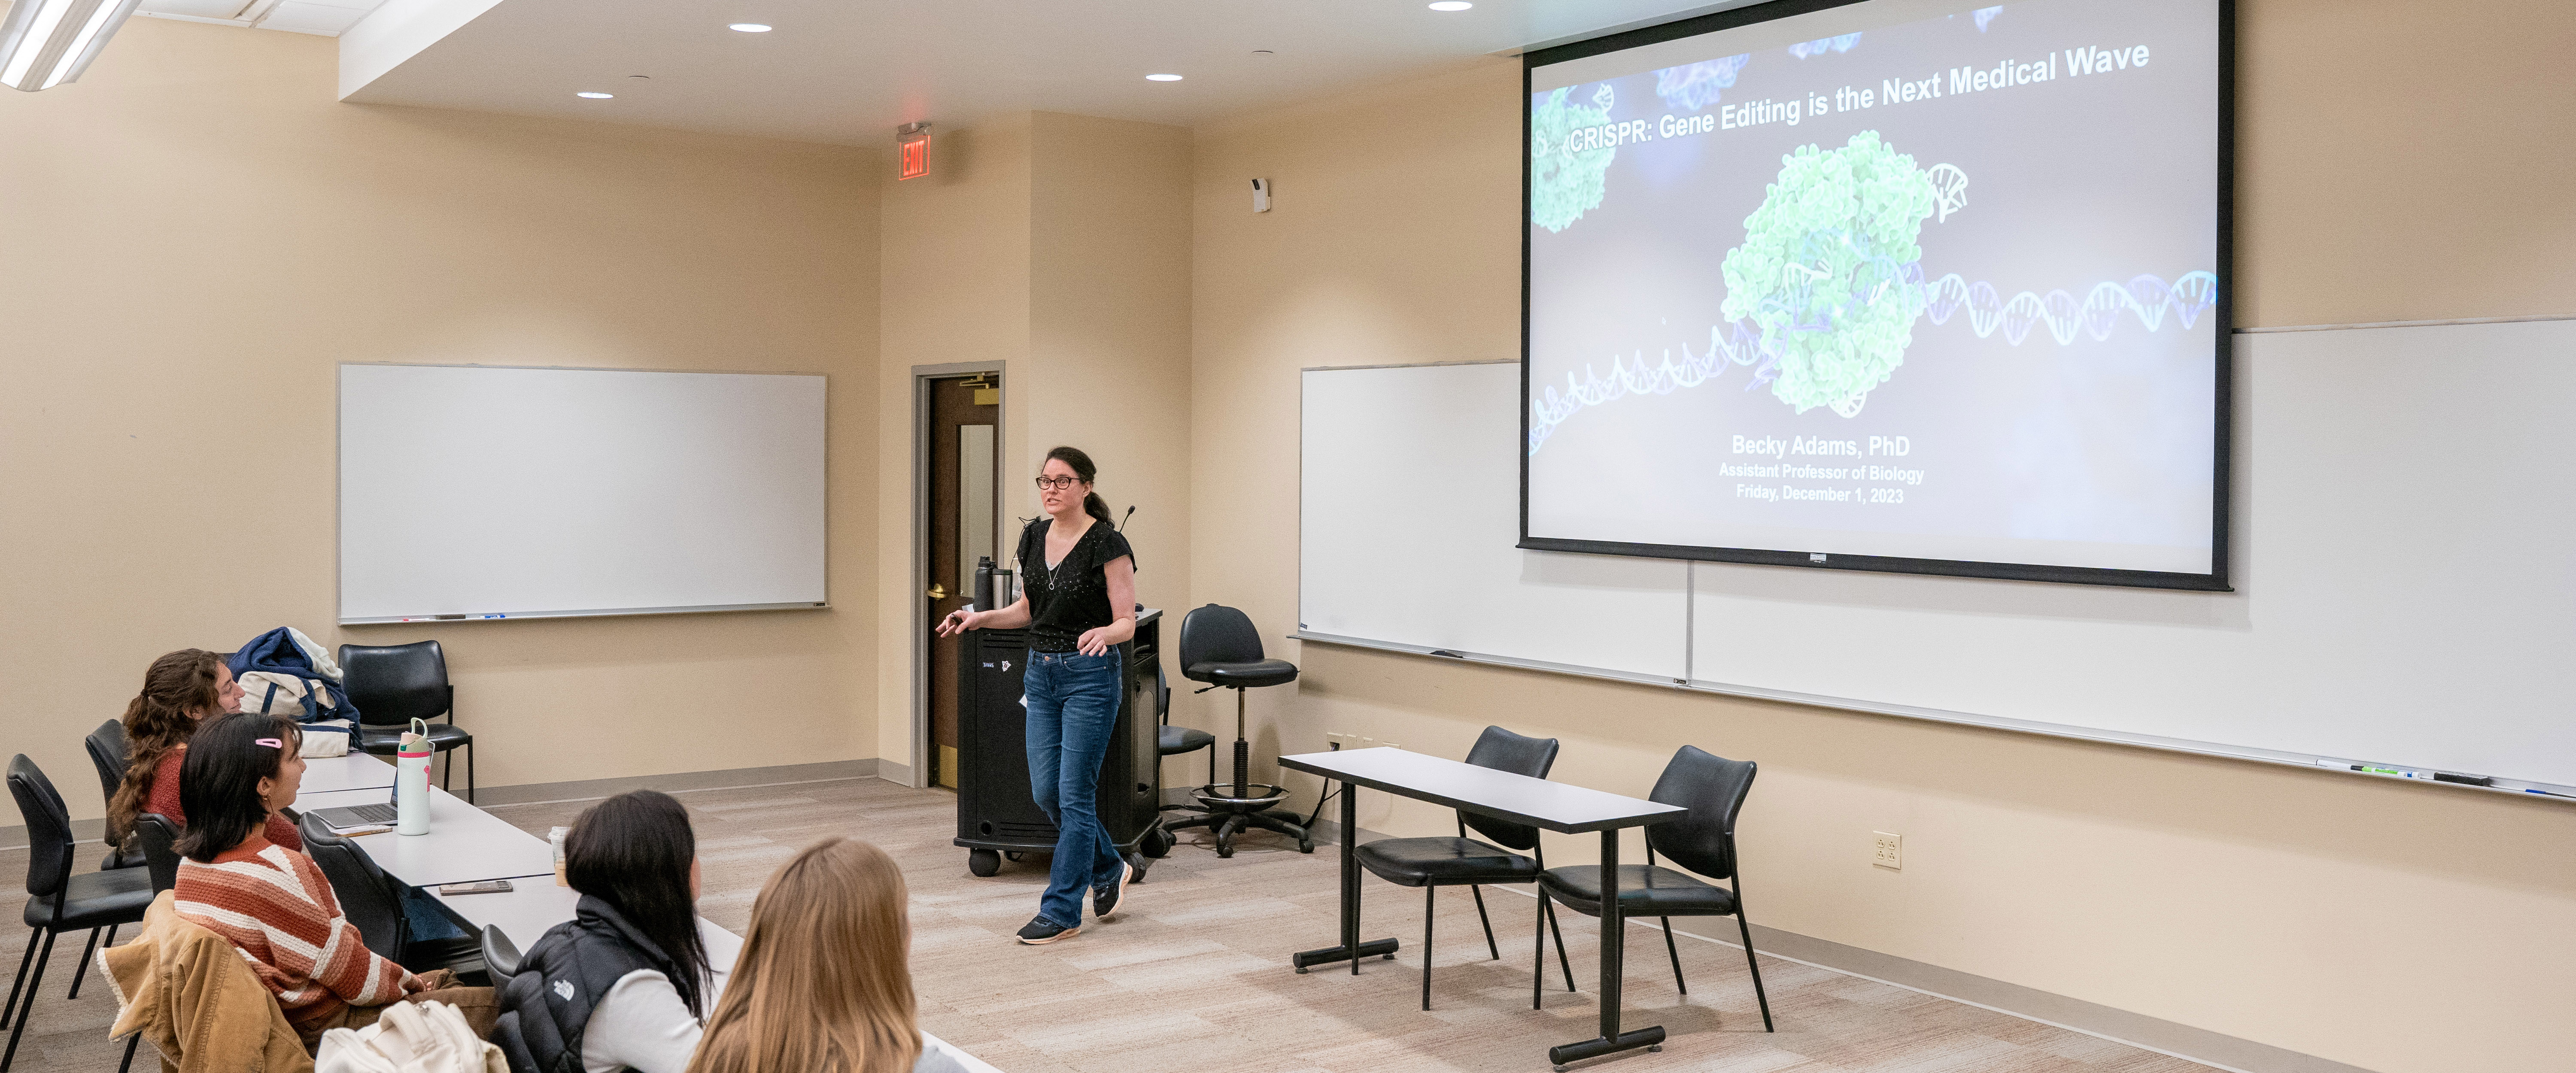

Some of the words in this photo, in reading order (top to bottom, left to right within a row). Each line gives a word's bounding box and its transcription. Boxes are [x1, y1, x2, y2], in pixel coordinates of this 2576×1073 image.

[1570, 120, 1652, 152] CRISPR:
[1659, 114, 1714, 138] Gene
[1722, 99, 1801, 129] Editing
[1808, 91, 1828, 116] is
[1835, 85, 1874, 112] the
[1883, 72, 1941, 105] Next
[1950, 52, 2055, 95] Medical
[2065, 45, 2149, 77] Wave
[903, 140, 925, 176] EXIT
[1732, 434, 1787, 459] Becky
[1791, 435, 1862, 459] Adams,
[1869, 436, 1910, 456] PhD
[1719, 462, 1779, 477] Assistant
[1783, 464, 1848, 479] Professor
[1851, 466, 1866, 479] of
[1870, 465, 1924, 485] Biology
[1737, 484, 1779, 502] Friday,
[1783, 485, 1850, 501] December
[1855, 488, 1866, 504] 1,
[1870, 488, 1904, 503] 2023
